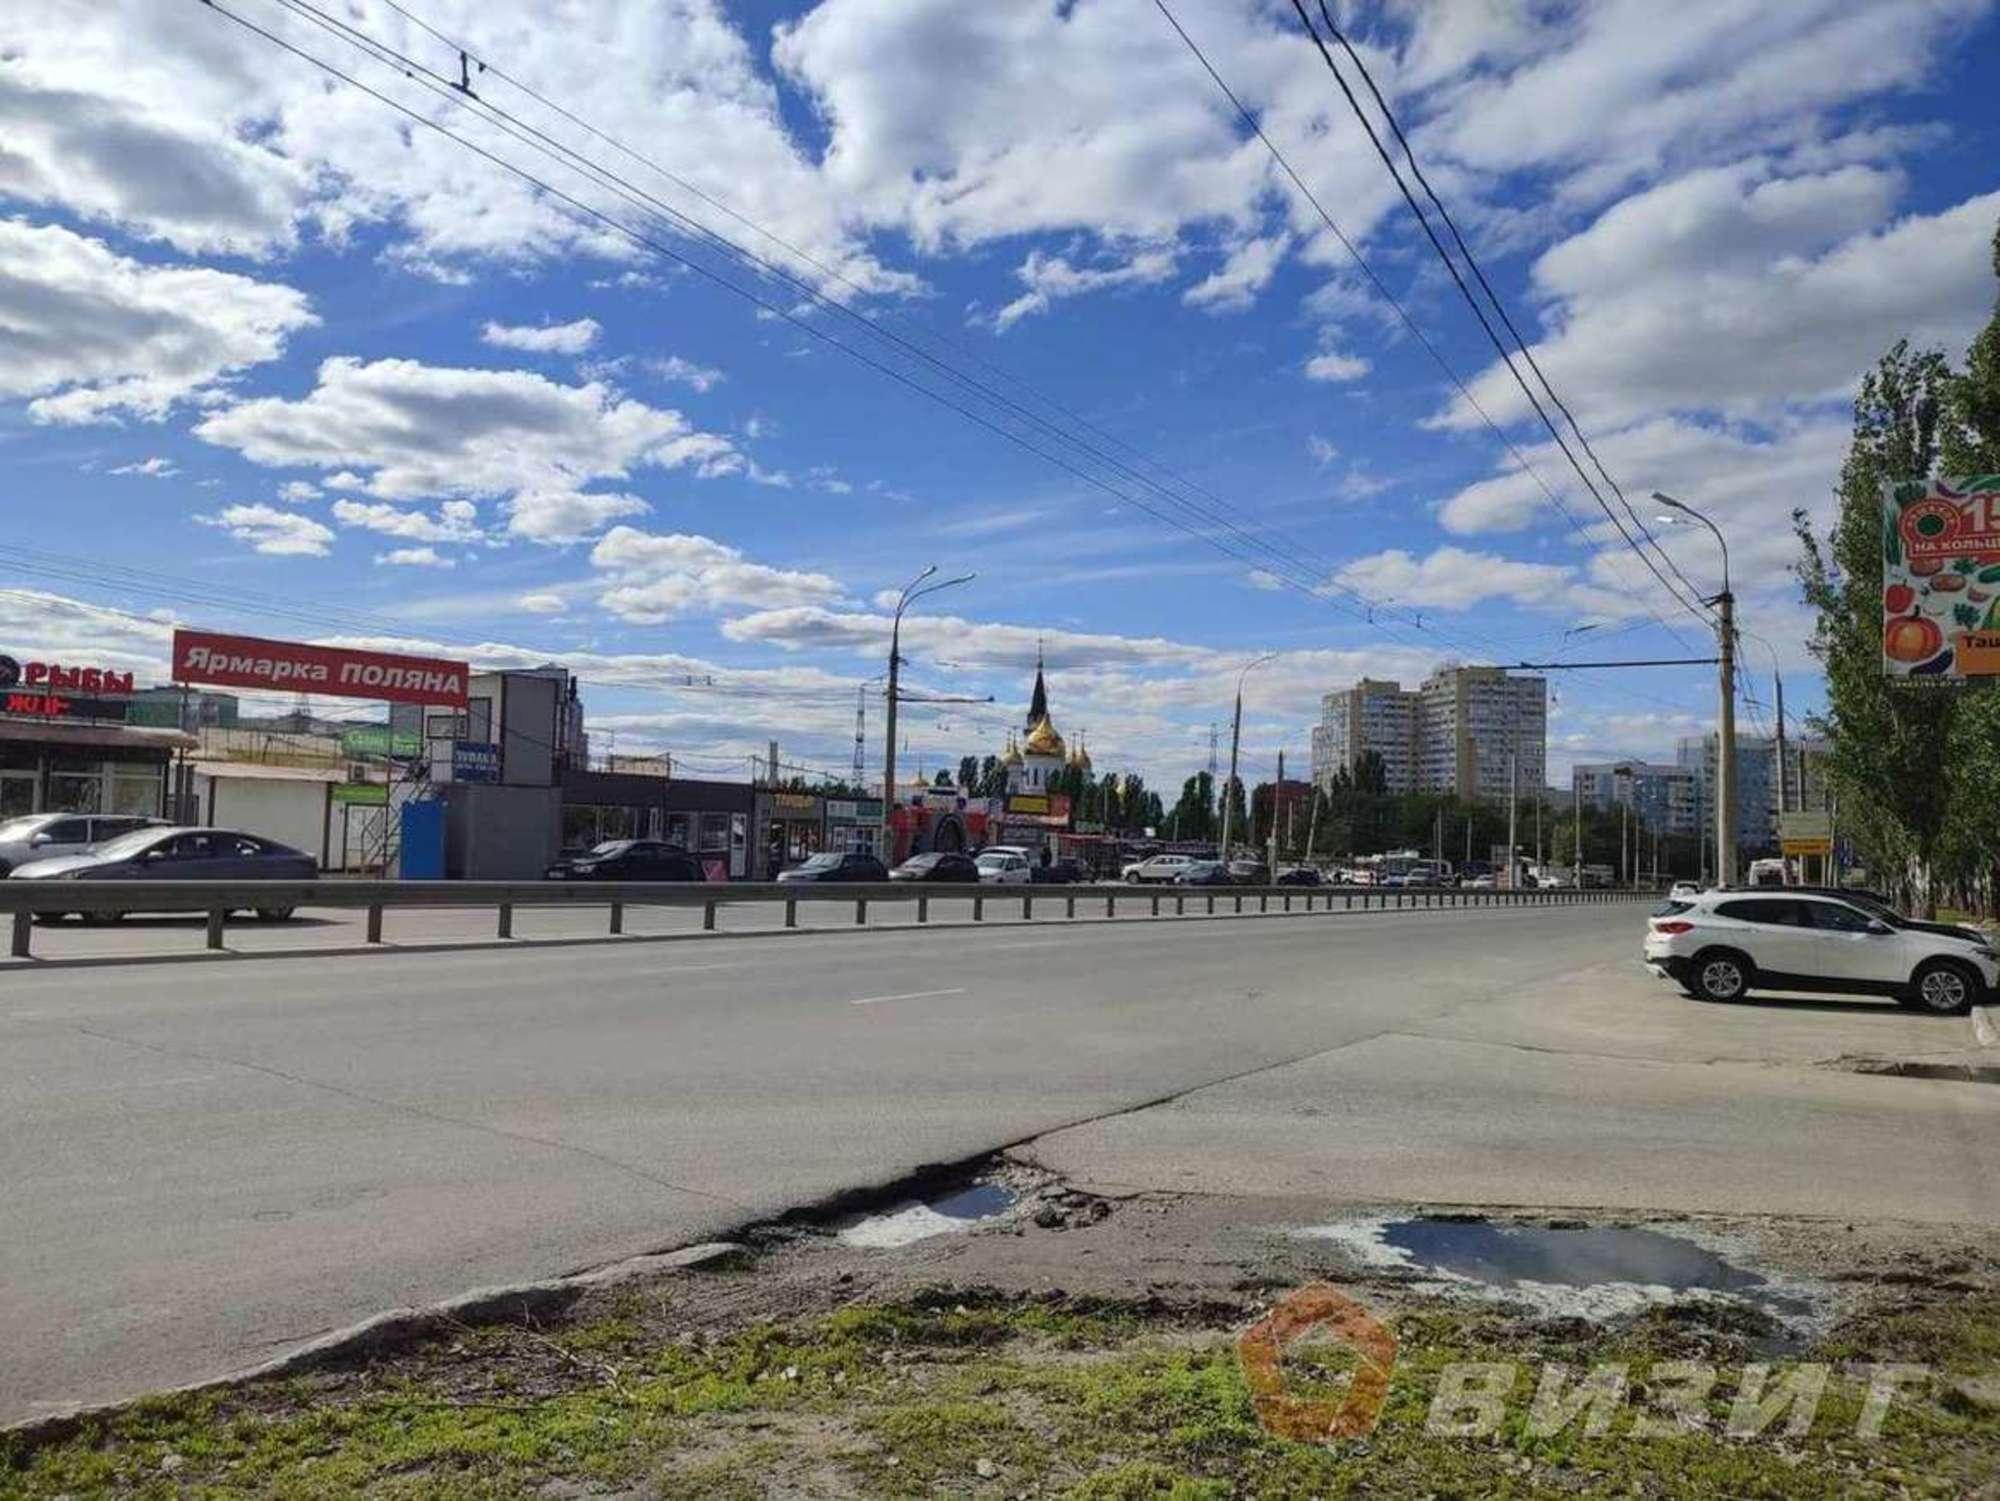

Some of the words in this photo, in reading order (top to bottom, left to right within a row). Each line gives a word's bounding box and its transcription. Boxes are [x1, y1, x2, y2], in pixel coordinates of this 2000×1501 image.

[1913, 541, 1937, 553] НА
[1942, 538, 2000, 551] КОЛЬЦ
[25, 661, 134, 693] РЫБЫ
[184, 645, 328, 682] Ярмарка
[339, 662, 461, 695] ПОЛЯНА
